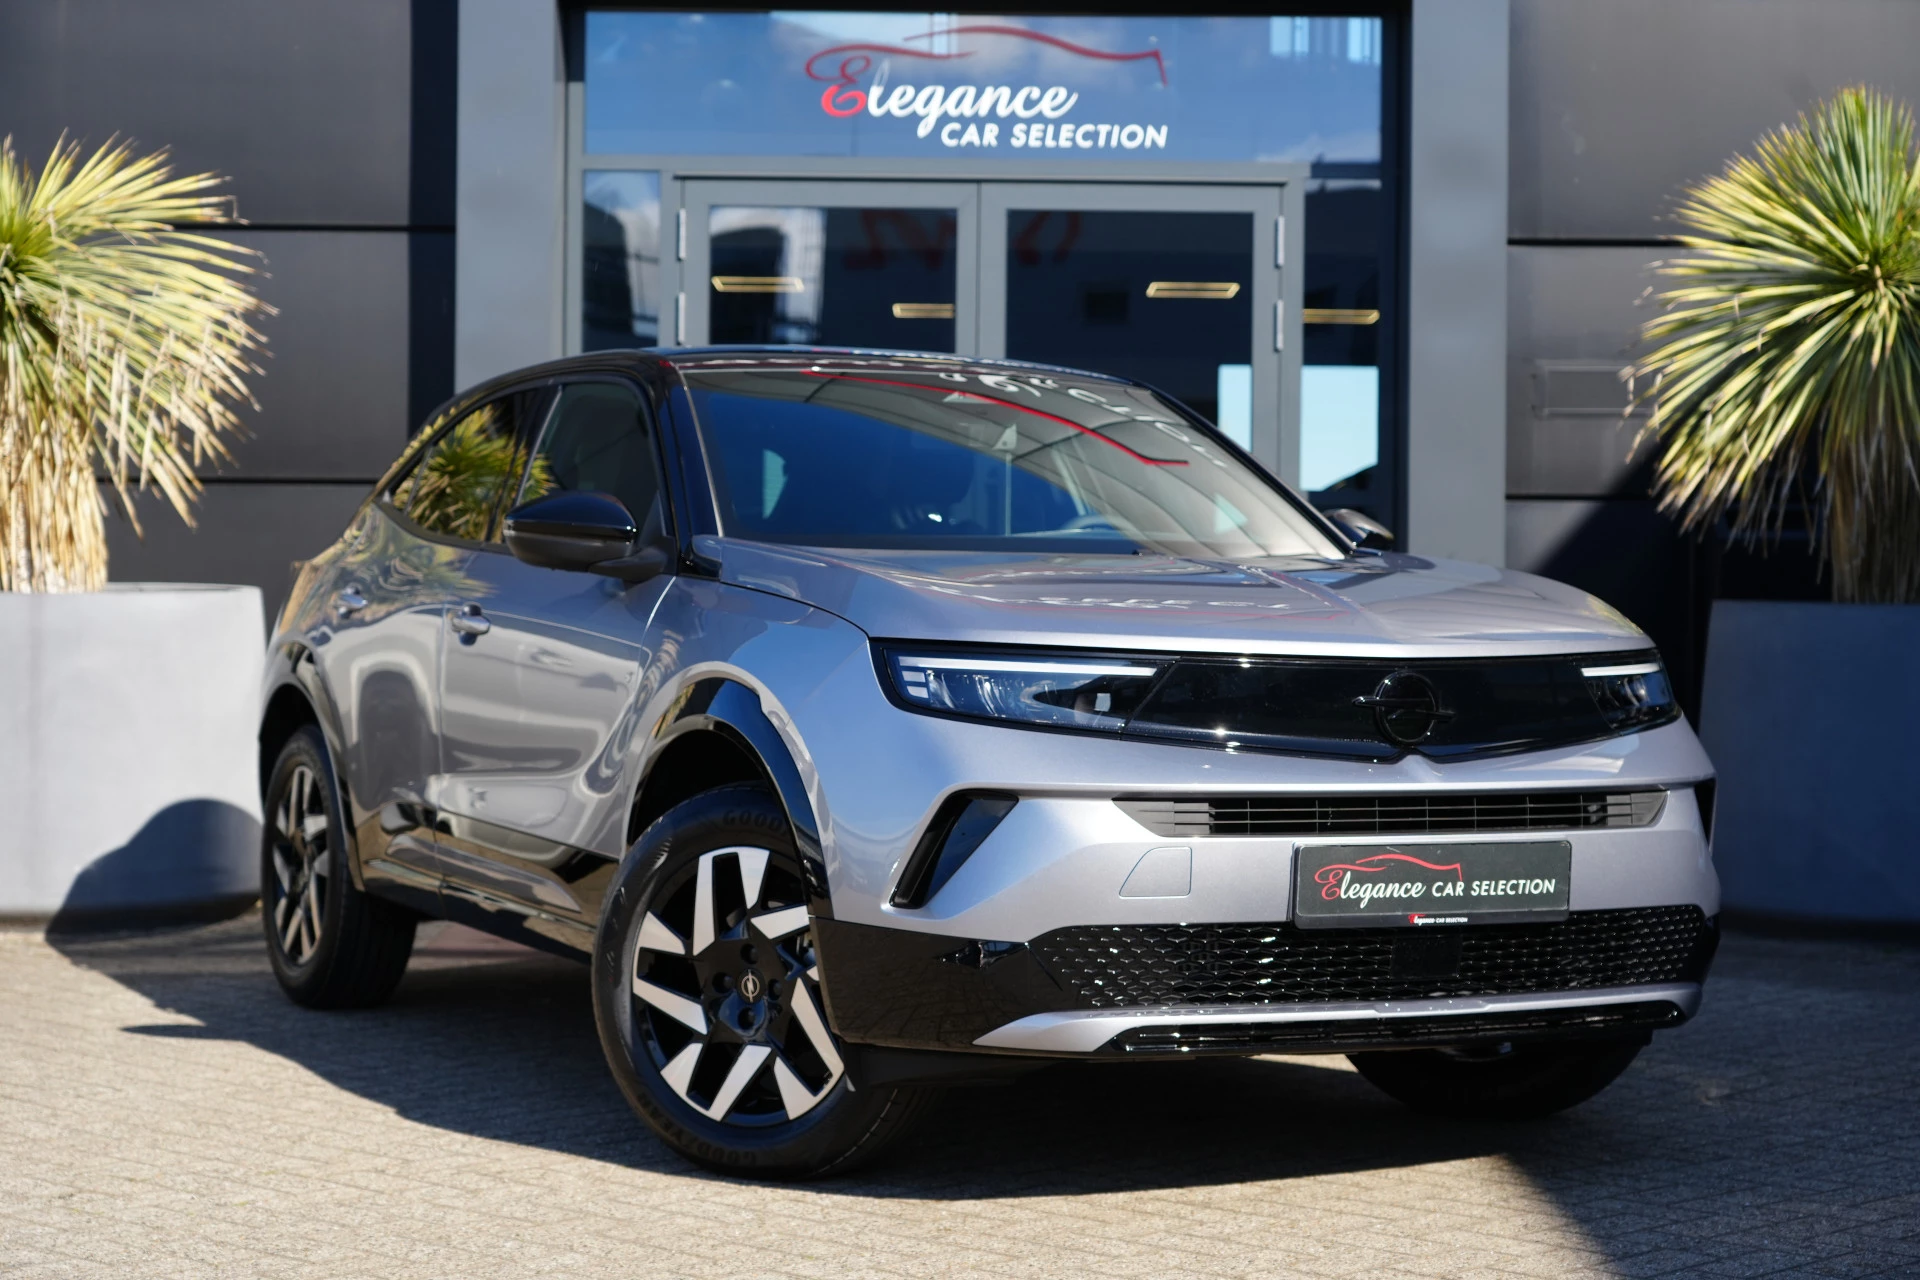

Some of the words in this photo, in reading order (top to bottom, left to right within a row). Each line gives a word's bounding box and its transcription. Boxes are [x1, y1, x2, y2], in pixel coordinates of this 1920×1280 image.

[806, 54, 1078, 138] Elegance
[940, 122, 999, 148] CAR
[1010, 123, 1168, 149] SELECTION
[1314, 869, 1426, 908] Elegance
[1432, 881, 1464, 897] CAR
[1471, 879, 1556, 896] SELECTION
